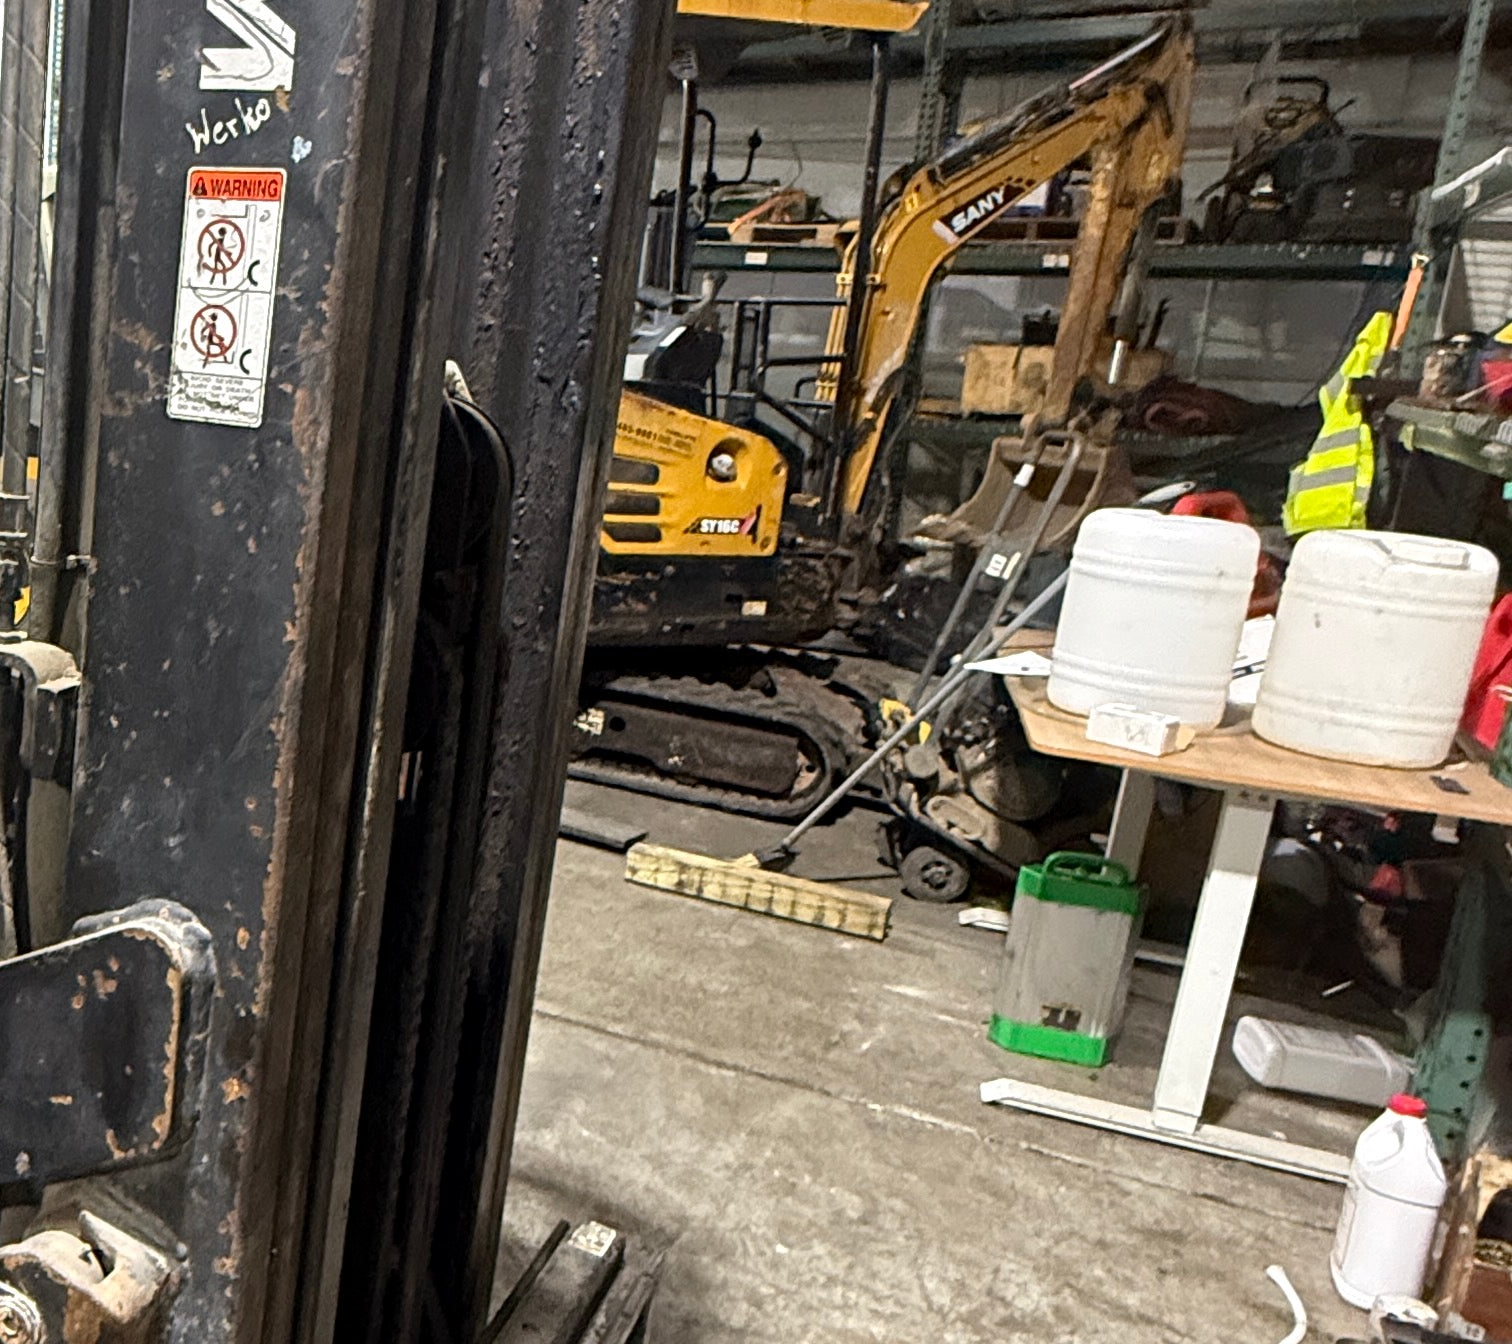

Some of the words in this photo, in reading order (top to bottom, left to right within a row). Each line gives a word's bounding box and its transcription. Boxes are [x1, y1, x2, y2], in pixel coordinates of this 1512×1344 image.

[210, 177, 279, 199] WARNING
[951, 184, 1006, 233] SANY
[699, 518, 740, 534] SY16C
